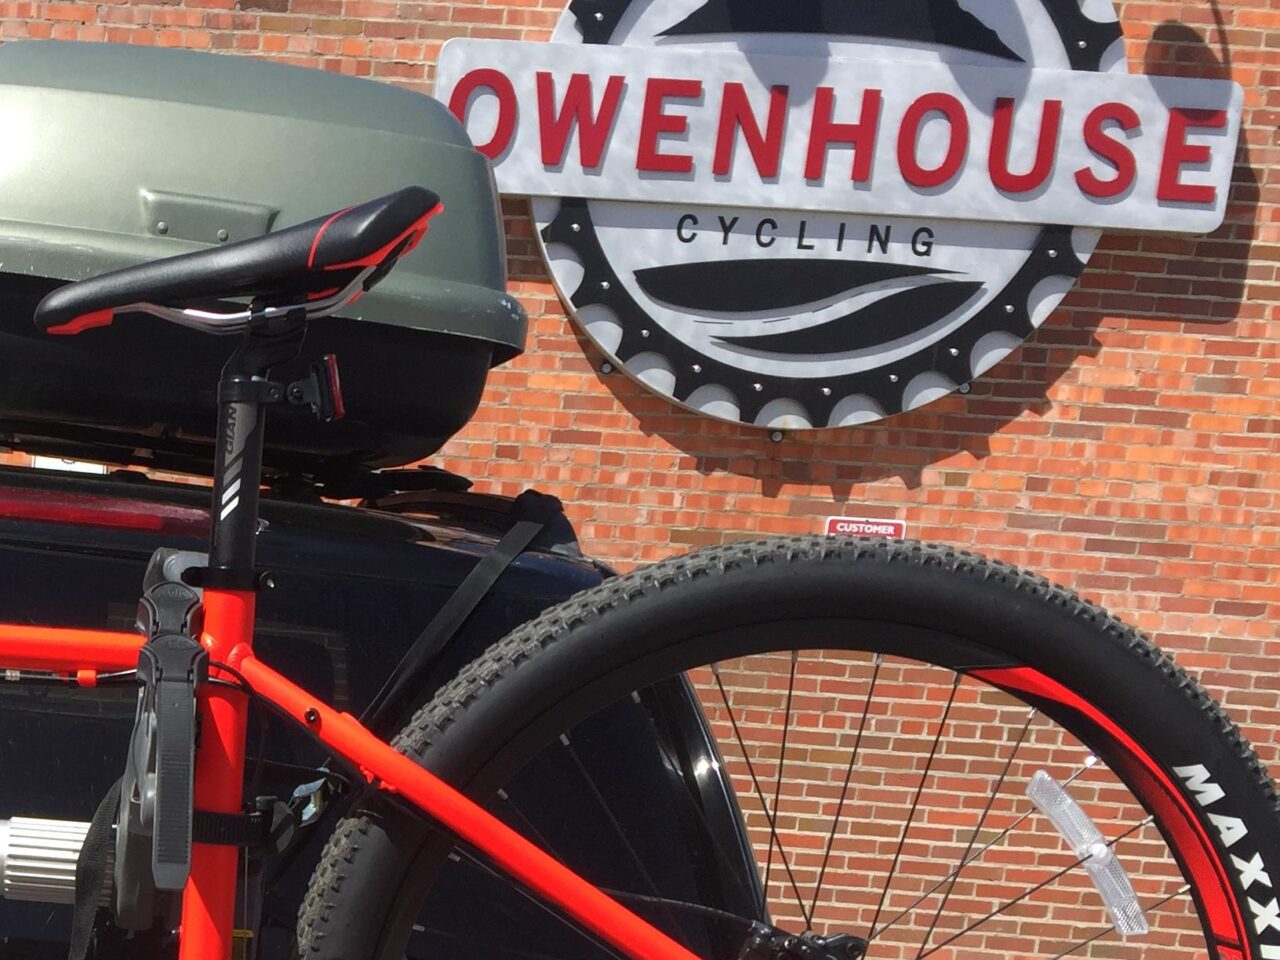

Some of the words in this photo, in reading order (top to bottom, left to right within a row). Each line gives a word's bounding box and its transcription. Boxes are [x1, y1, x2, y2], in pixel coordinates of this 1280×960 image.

[449, 67, 1228, 202] OWENHOUSE
[677, 213, 936, 257] CYCLING
[225, 405, 237, 455] GIAN
[836, 523, 895, 534] CUSTOMER
